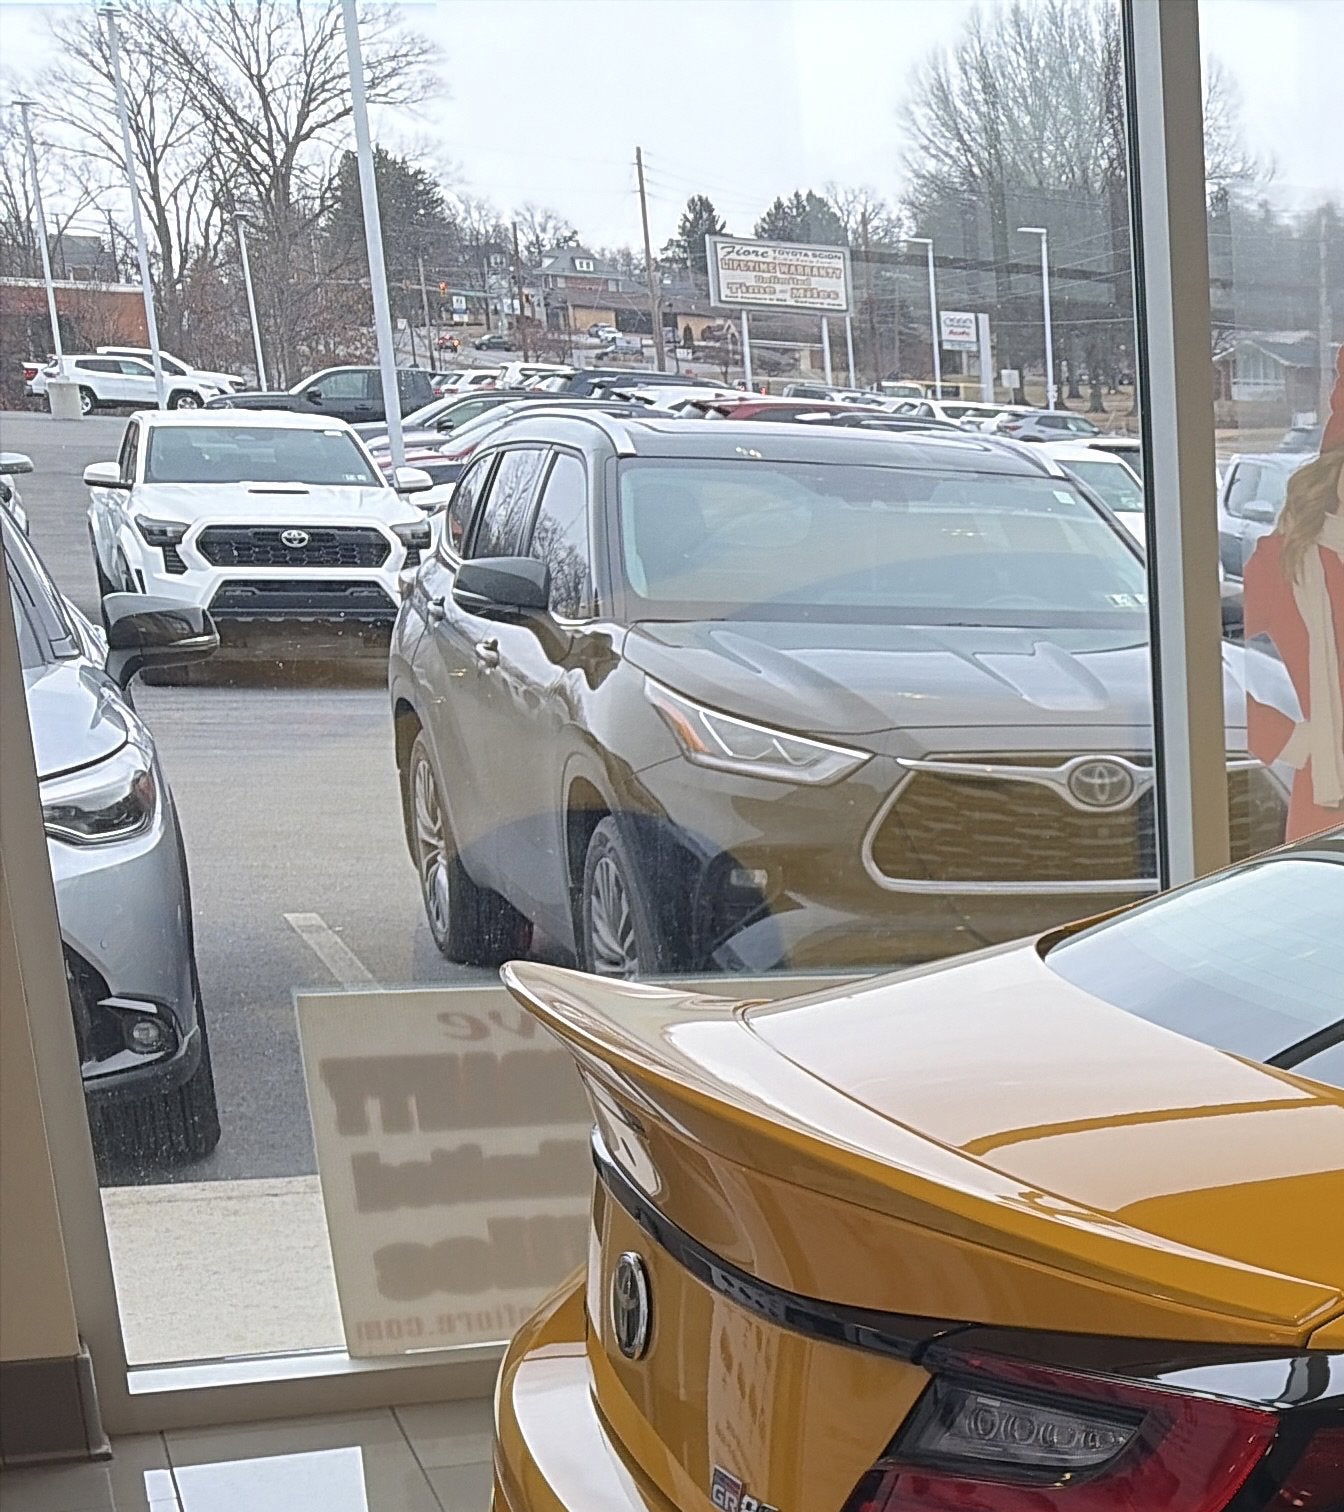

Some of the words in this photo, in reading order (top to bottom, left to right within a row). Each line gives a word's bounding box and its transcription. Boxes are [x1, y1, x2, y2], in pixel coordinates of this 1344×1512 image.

[772, 249, 809, 258] TOYOTA
[720, 258, 777, 273] LIFETIME
[779, 262, 842, 279] WARRANTY
